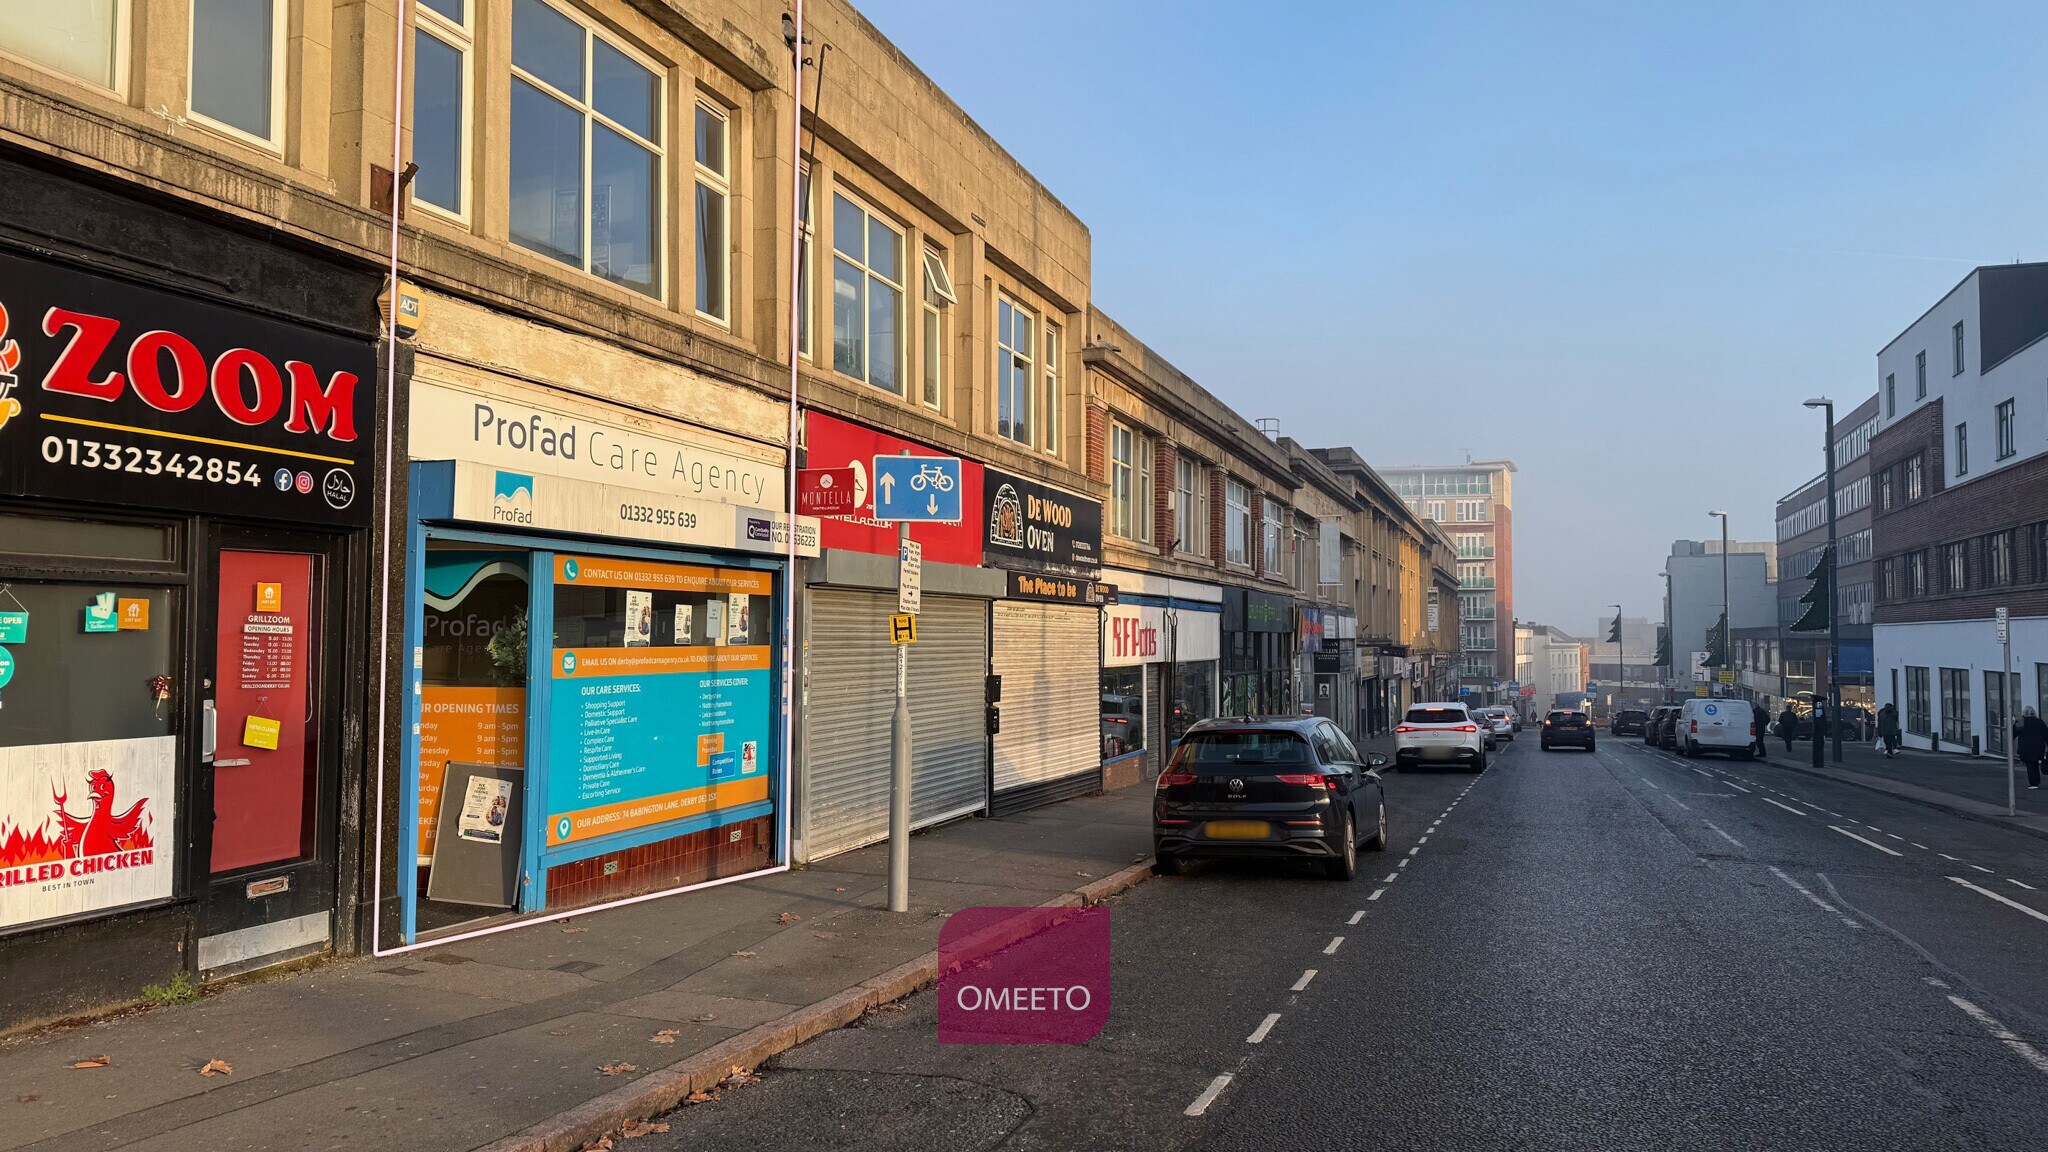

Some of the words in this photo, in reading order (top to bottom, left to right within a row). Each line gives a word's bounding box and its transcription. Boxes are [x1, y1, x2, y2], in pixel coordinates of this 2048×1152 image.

[400, 299, 419, 313] ADT
[41, 306, 358, 442] ZOOM
[474, 403, 576, 460] Profad
[589, 431, 658, 477] Care
[672, 450, 765, 504] Agency
[41, 435, 261, 488] 01332342854
[327, 490, 348, 502] HALAL
[801, 491, 852, 506] MONTELLA
[493, 505, 532, 524] Profad
[620, 503, 654, 523] 01332
[656, 508, 675, 526] 955
[677, 511, 697, 529] 639
[1027, 494, 1041, 521] DE
[1042, 498, 1072, 528] WOOD
[771, 521, 782, 531] OUR
[1027, 525, 1054, 553] OVEN
[583, 568, 613, 578] CONTACT
[613, 571, 623, 580] US
[623, 571, 633, 580] ON
[634, 572, 652, 582] 01332
[652, 573, 663, 582] 955
[664, 574, 675, 583] 639
[676, 575, 683, 584] TO
[684, 576, 708, 586] ENQUIRE
[709, 577, 726, 587] ABOUT
[726, 578, 737, 587] OUR
[737, 579, 760, 588] SERVICES
[1018, 575, 1034, 594] The
[1035, 577, 1056, 595] Place
[1057, 580, 1066, 597] to
[1067, 581, 1077, 598] be
[3, 616, 23, 625] OPEN
[248, 614, 290, 624] GRILLZOOM
[424, 614, 507, 637] Profad
[893, 616, 913, 641] H
[581, 658, 599, 666] EMAIL
[600, 658, 608, 666] US
[608, 657, 617, 665] ON
[696, 655, 717, 663] ENQUIRE
[717, 654, 731, 662] ABOUT
[740, 653, 758, 661] SERVICES
[700, 680, 710, 688] OUR
[710, 679, 733, 687] SERVICES
[581, 686, 596, 696] OUR
[596, 685, 612, 695] CARE
[612, 683, 641, 694] SERVICES:
[433, 703, 484, 714] OPENING
[485, 703, 519, 714] TIMES
[585, 702, 608, 710] Shopping
[607, 700, 626, 708] Support
[702, 701, 733, 709] Nottinghamshire
[585, 709, 606, 718] Domestic
[606, 709, 626, 717] Support
[420, 722, 438, 730] nday
[501, 722, 519, 731] 5pm
[585, 719, 606, 727] Palliative
[606, 717, 628, 726] Specialist
[701, 719, 735, 727] Northamptonshire
[601, 727, 611, 735] Care
[501, 735, 519, 743] 5pm
[583, 738, 604, 746] Complex
[501, 747, 519, 756] 5pm
[583, 746, 601, 754] Respite
[583, 754, 608, 763] Supported
[608, 752, 623, 760] Living
[712, 757, 734, 766] Competitive
[583, 763, 609, 772] Domiciliary
[609, 761, 620, 769] Care
[583, 772, 606, 781] Dementia
[583, 782, 600, 790] Private
[582, 790, 605, 799] Escorting
[604, 787, 621, 796] Service
[576, 818, 592, 829] OUR
[591, 812, 622, 826] ADDRESS:
[622, 810, 630, 820] 74
[629, 803, 664, 818] BABINGTON
[680, 796, 699, 807] DERBY
[0, 863, 65, 889] RILLED
[69, 849, 154, 877] CHICKEN
[42, 883, 61, 892] BEST
[73, 878, 95, 888] TOWN
